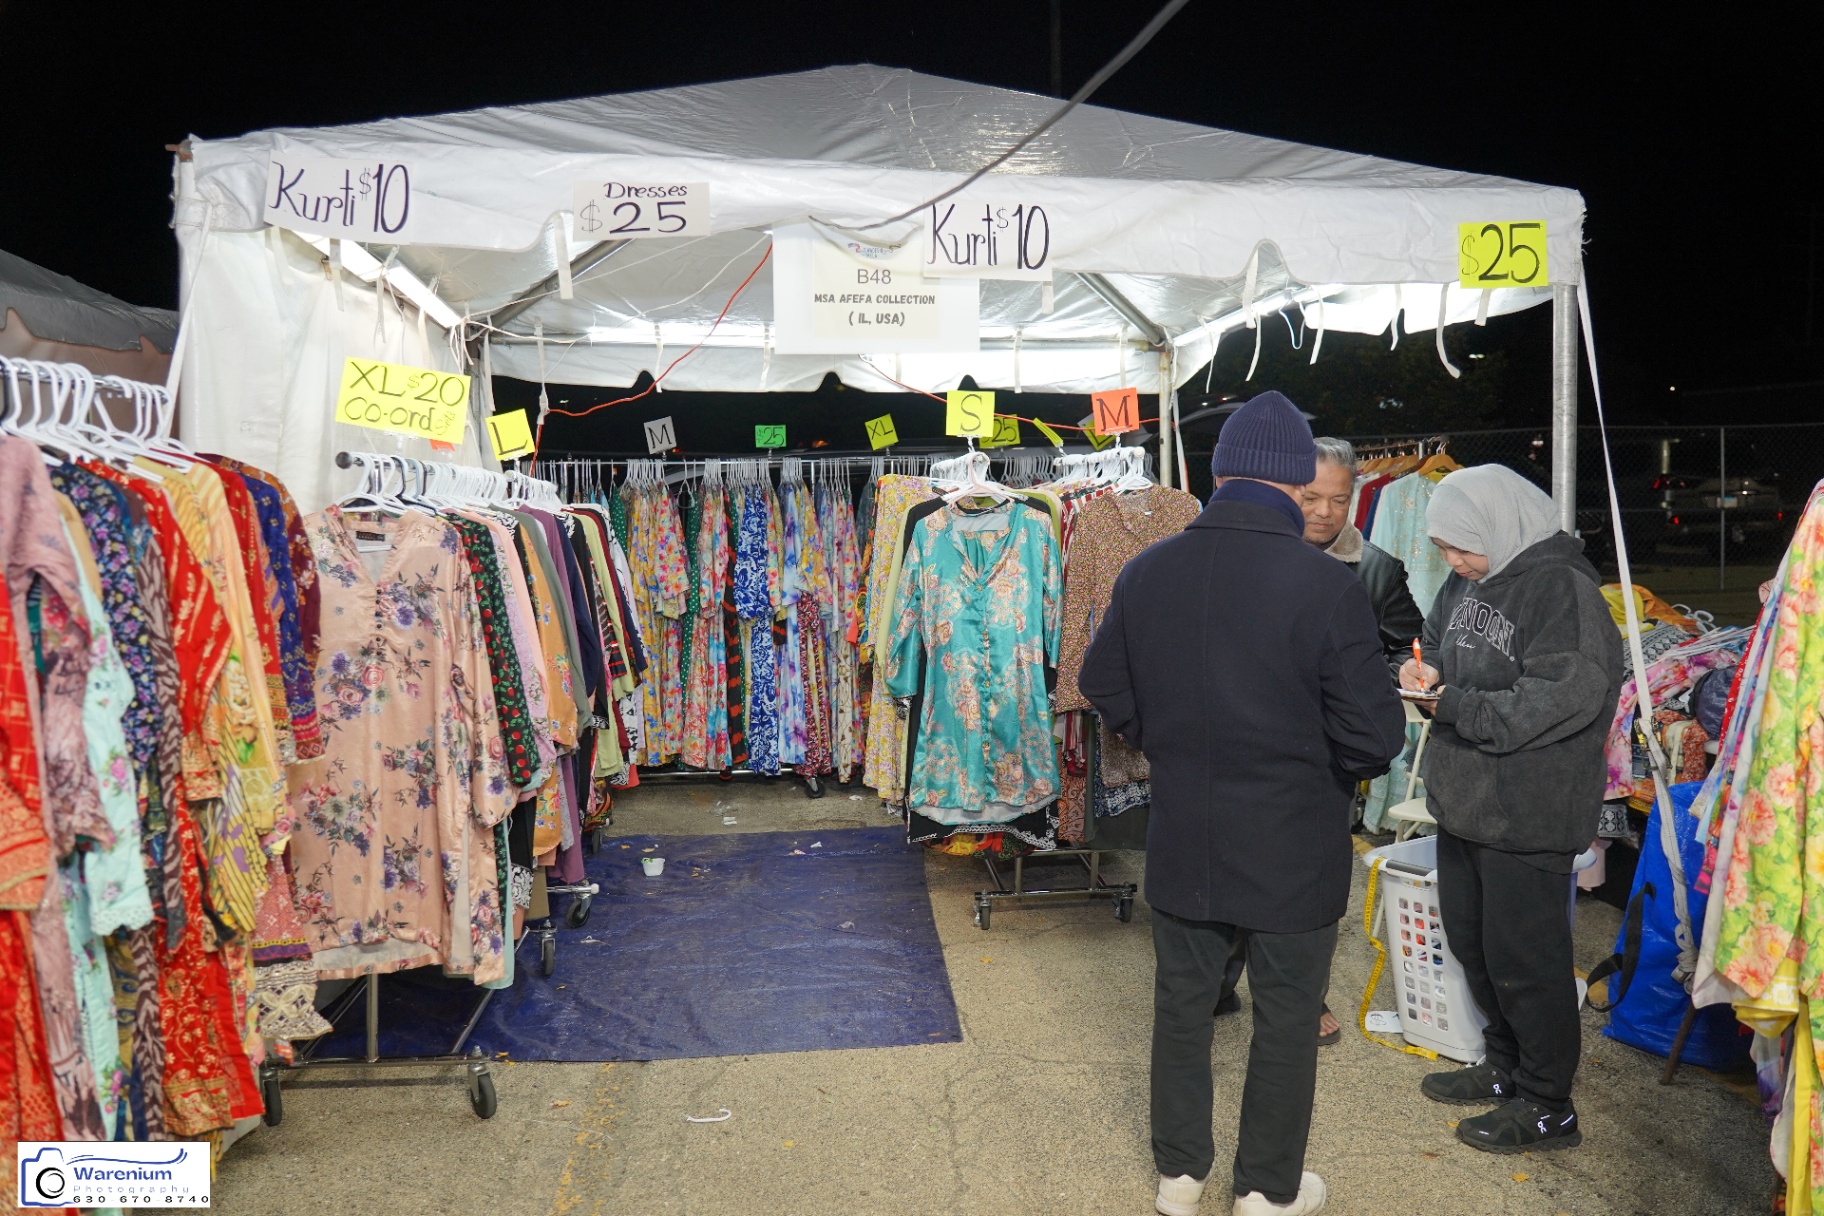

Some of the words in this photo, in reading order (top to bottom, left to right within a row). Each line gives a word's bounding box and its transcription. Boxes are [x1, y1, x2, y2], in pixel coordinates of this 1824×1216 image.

[268, 160, 355, 226] Kurti
[358, 163, 410, 234] $10
[603, 182, 688, 199] Dresses
[580, 199, 687, 235] $25
[927, 203, 998, 266] Kurti
[996, 203, 1049, 270] $10
[1461, 222, 1543, 284] $25
[857, 268, 892, 285] B48
[814, 293, 836, 303] MSA
[839, 294, 873, 304] AFEFA
[876, 294, 936, 305] COLLECTION
[350, 361, 407, 398] XL
[407, 372, 465, 407] $20
[867, 419, 894, 440] XL
[960, 393, 983, 432] S
[1096, 395, 1131, 431] M
[488, 421, 528, 456] L
[647, 424, 672, 449] M
[756, 426, 785, 448] $25
